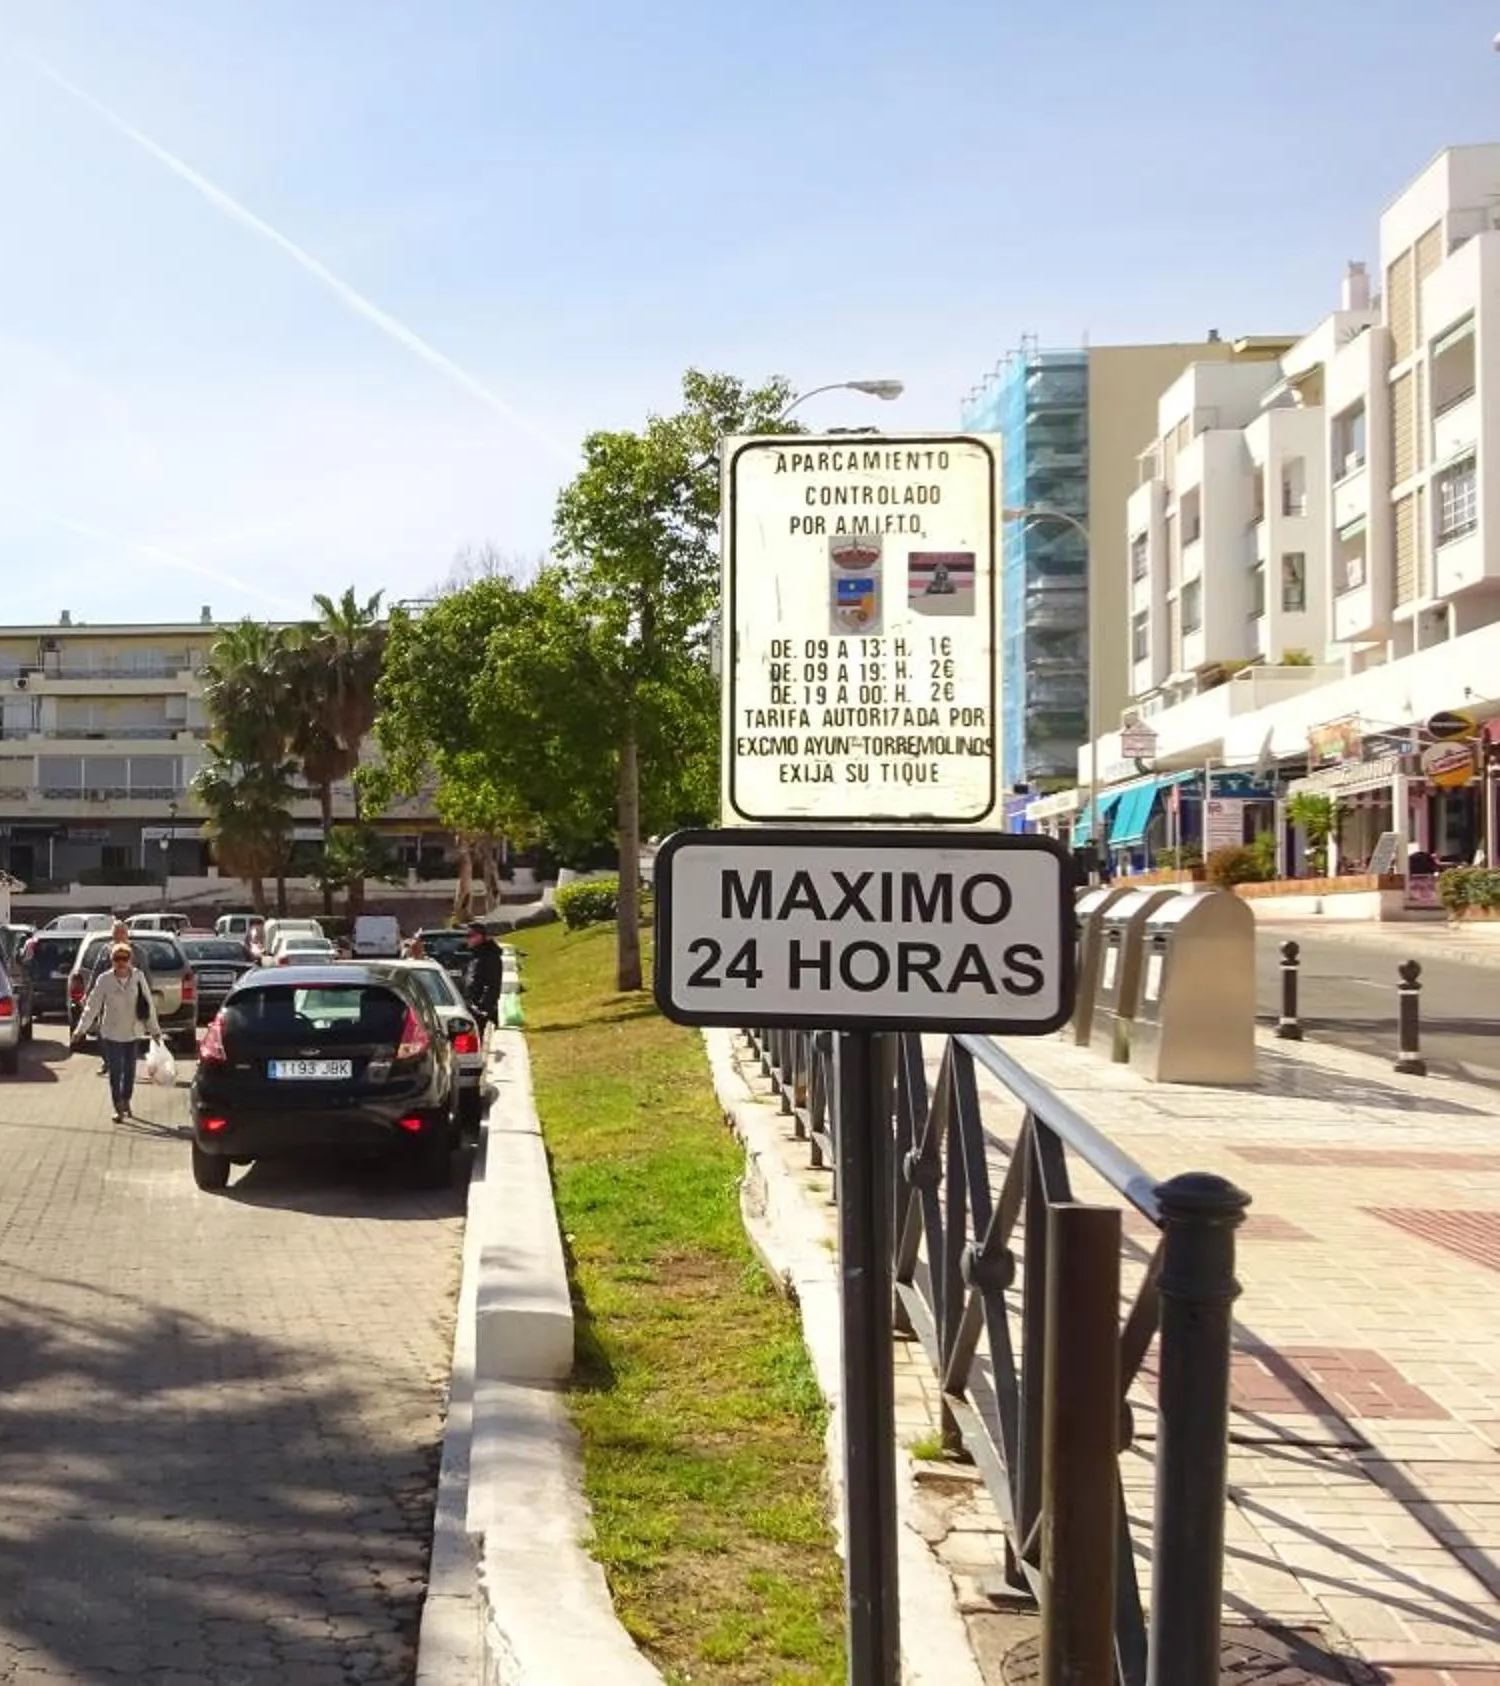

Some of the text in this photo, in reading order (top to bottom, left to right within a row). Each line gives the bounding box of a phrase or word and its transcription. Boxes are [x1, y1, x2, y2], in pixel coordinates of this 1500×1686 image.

[775, 451, 949, 473] APARCAMIENTO
[805, 485, 941, 506] CONTROLADO
[790, 515, 826, 535] POR
[805, 639, 828, 659] 09
[837, 640, 849, 659] A
[930, 636, 952, 657] 1€
[804, 662, 828, 682] 09
[837, 664, 849, 682] A
[930, 659, 954, 679] 2€
[804, 685, 827, 705] 19
[837, 685, 849, 704] A
[930, 682, 954, 702] 2€
[744, 708, 810, 728] TARIFA
[949, 707, 985, 727] POR
[737, 736, 798, 756] EXCMO
[780, 762, 939, 786] EXIJA SU TIQUE
[721, 870, 1012, 924] MAXIMO
[687, 937, 1045, 996] 24 HORAS
[282, 1061, 317, 1075] 1193
